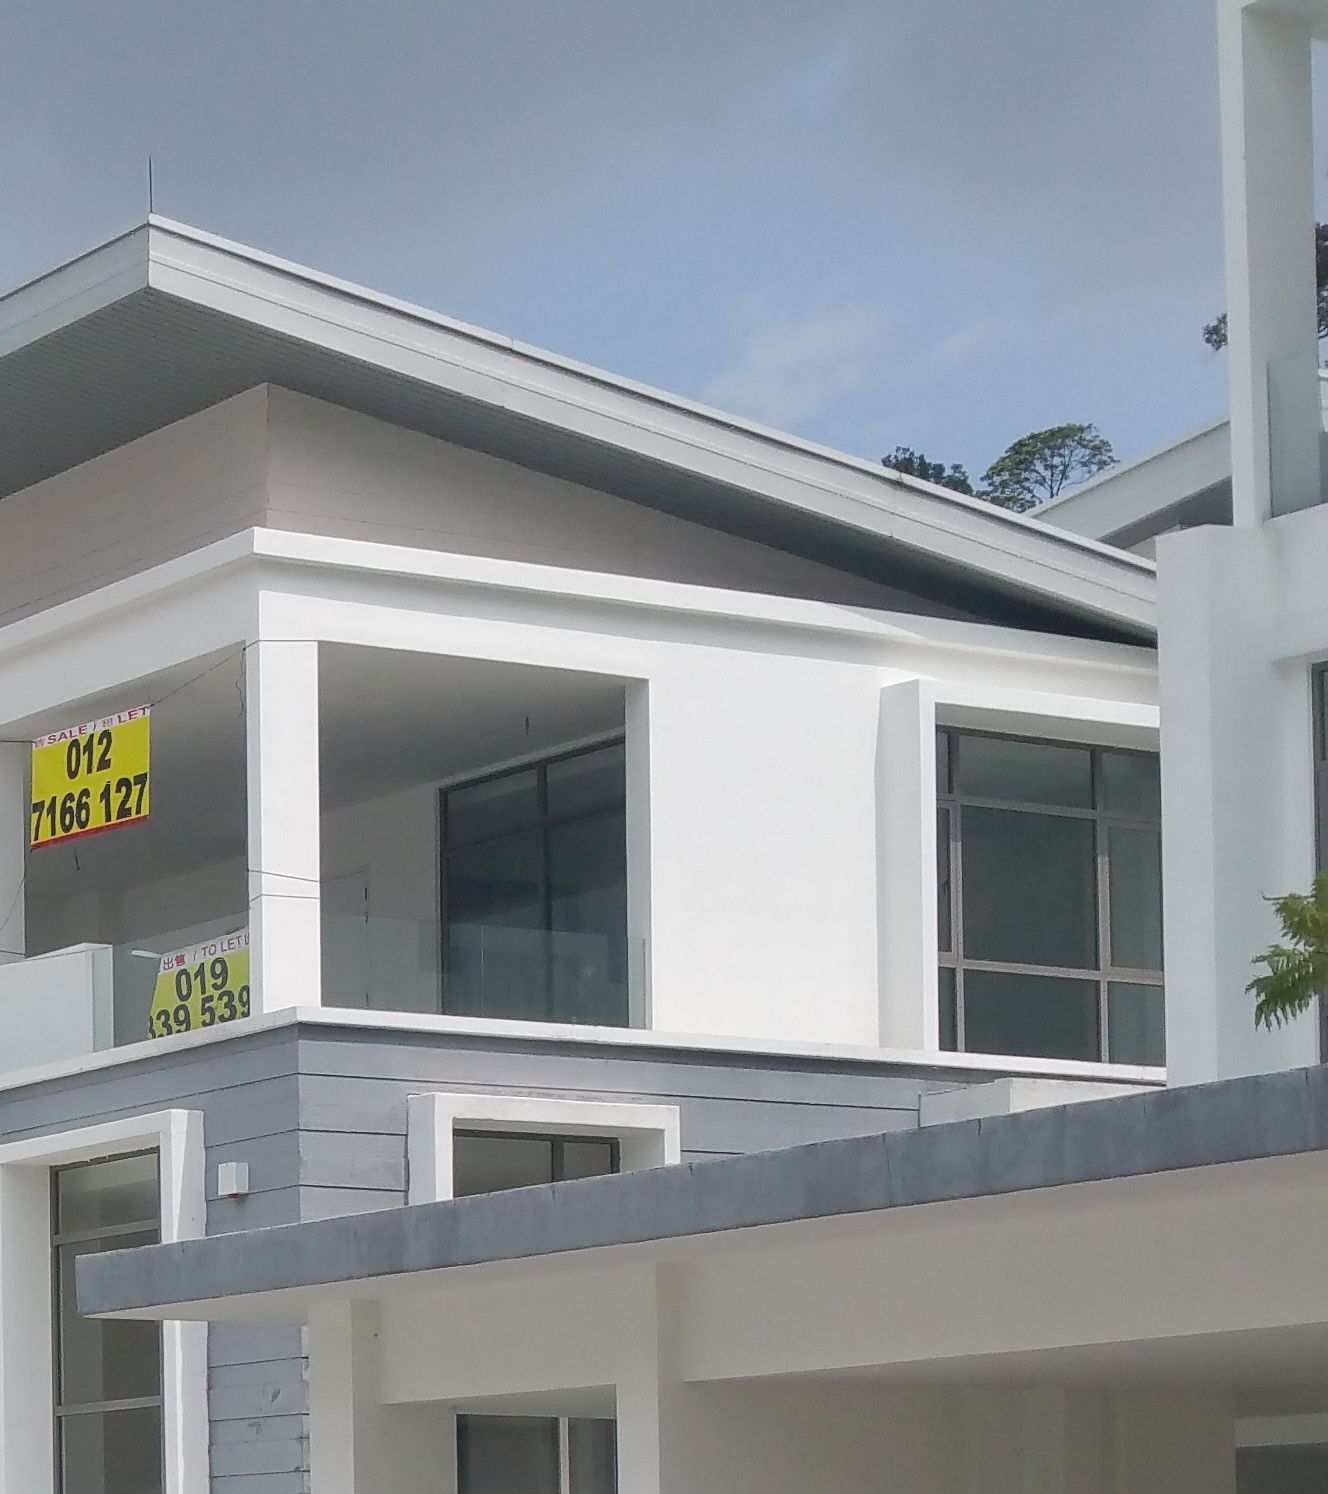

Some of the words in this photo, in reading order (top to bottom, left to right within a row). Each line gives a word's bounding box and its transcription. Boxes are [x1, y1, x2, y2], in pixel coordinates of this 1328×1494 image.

[47, 724, 87, 745] SALE
[118, 706, 150, 724] LET
[66, 730, 113, 780] 012
[32, 788, 91, 842] 7166
[100, 772, 148, 823] 127
[201, 944, 217, 957] TO
[220, 935, 244, 952] LET
[176, 957, 229, 1002] 019
[201, 985, 250, 1027] 539
